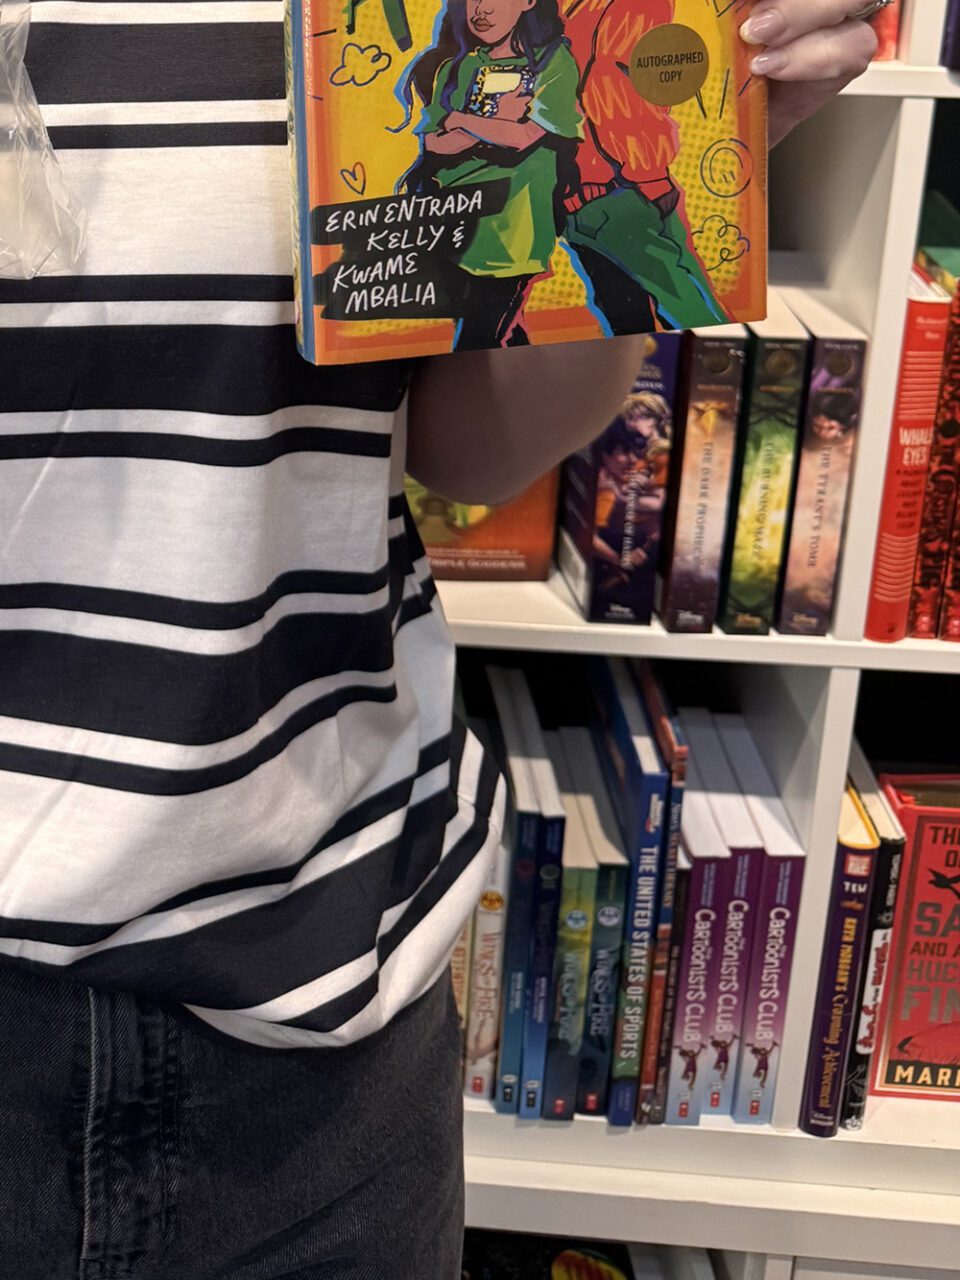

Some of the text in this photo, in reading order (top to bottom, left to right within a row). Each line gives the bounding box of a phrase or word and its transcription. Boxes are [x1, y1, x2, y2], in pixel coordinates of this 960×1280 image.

[637, 51, 704, 69] AUTOGRAPHED
[659, 70, 683, 83] COPY
[325, 190, 482, 232] ERIN ENTRADA
[367, 224, 444, 251] KELLY
[332, 252, 419, 293] KWAME
[345, 282, 436, 314] MBALIA
[903, 447, 928, 466] EYES
[639, 846, 658, 873] THE
[843, 881, 867, 894] TEW
[634, 876, 656, 933] UNITED
[628, 933, 651, 982] STATES
[910, 941, 947, 957] AND
[626, 983, 641, 1004] OF
[683, 1003, 705, 1043] CLUB
[715, 994, 737, 1033] CLUB
[755, 1002, 777, 1040] CLUB
[620, 1006, 642, 1060] SPORTS
